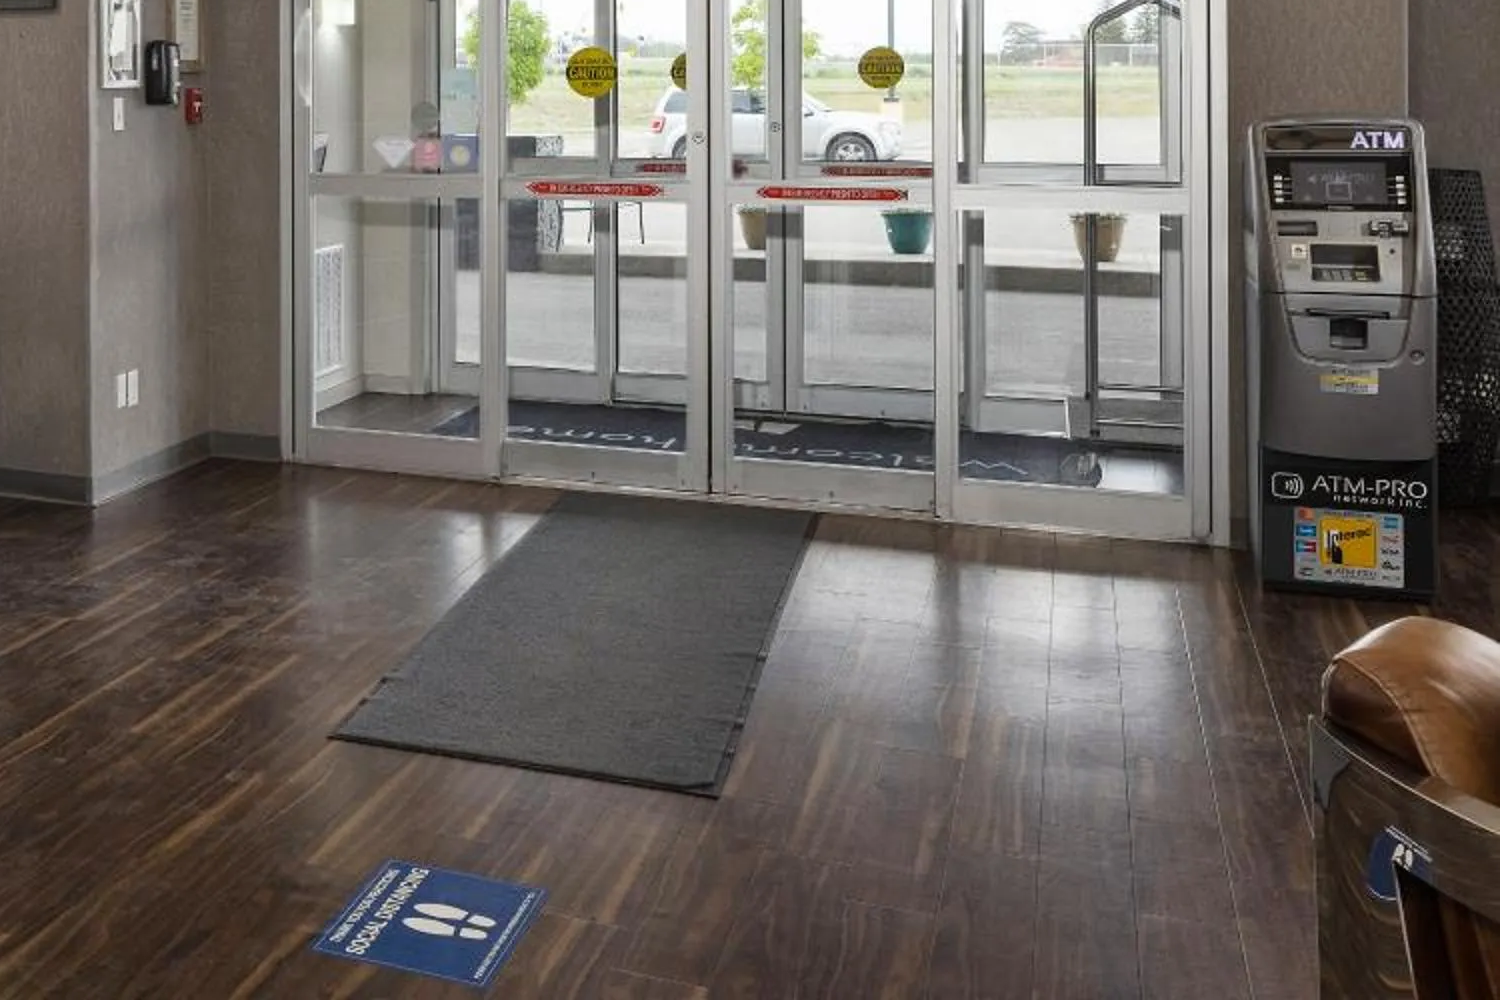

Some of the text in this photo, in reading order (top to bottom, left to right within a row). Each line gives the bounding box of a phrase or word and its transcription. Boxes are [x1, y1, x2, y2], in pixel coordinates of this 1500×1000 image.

[569, 66, 613, 79] CAUTION
[1350, 131, 1405, 149] ATM
[1311, 475, 1428, 499] ATM-PRO
[1333, 494, 1395, 506] network
[345, 867, 430, 955] SOCIAL DISTANCING
